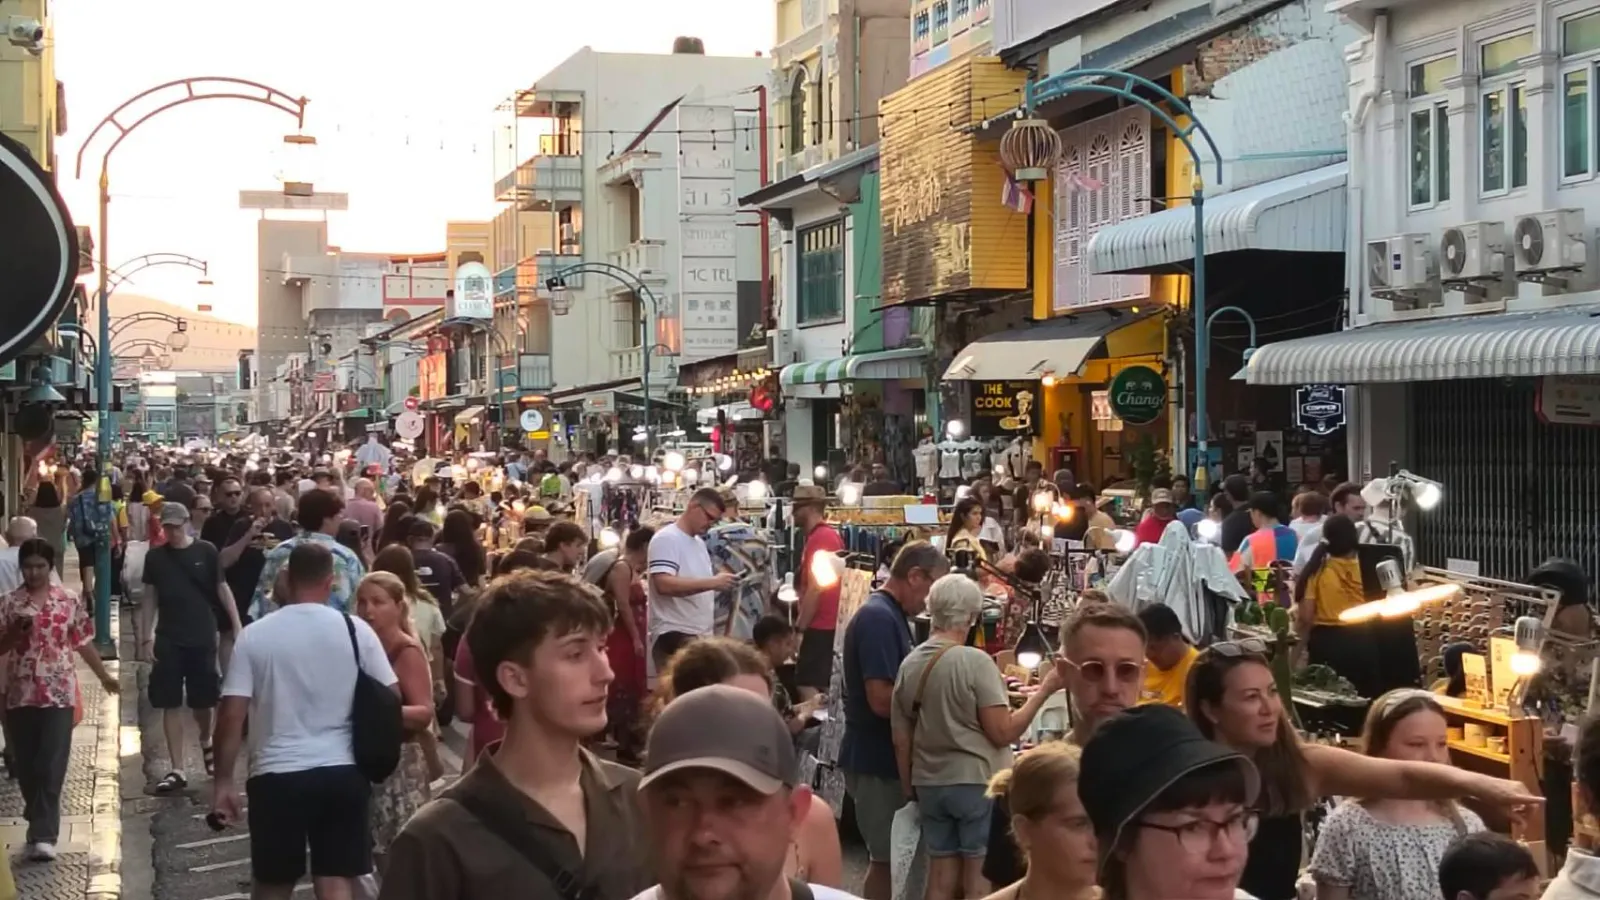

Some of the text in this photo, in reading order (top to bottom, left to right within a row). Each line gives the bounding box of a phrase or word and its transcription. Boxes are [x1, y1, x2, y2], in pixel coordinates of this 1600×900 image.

[983, 384, 1003, 394] THE
[975, 397, 1012, 408] COOK
[1117, 391, 1164, 408] Chang
